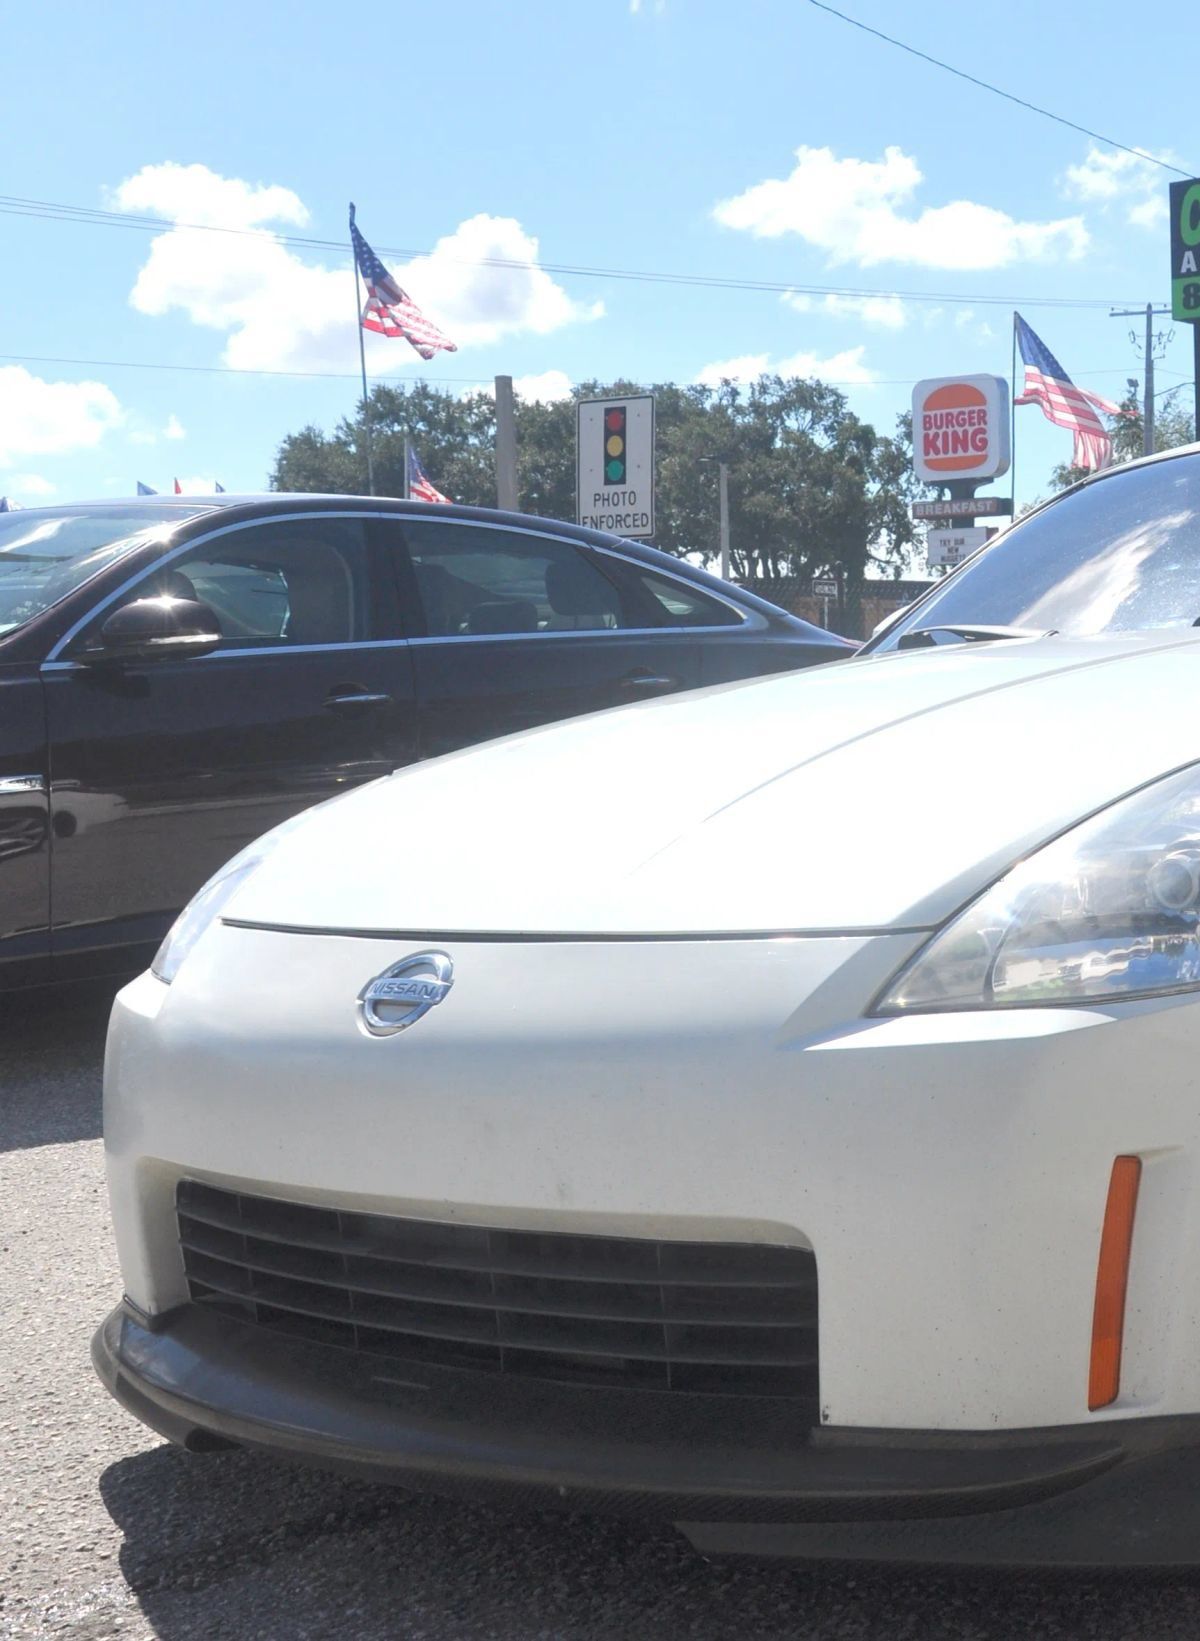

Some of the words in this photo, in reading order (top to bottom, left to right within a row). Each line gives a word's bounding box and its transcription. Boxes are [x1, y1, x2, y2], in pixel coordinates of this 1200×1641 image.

[923, 409, 988, 431] BURGER
[923, 427, 988, 457] KING
[593, 491, 637, 508] PHOTO
[916, 500, 993, 515] BREAKFAST
[582, 513, 649, 529] ENFORCED
[372, 982, 436, 997] NISSAN
